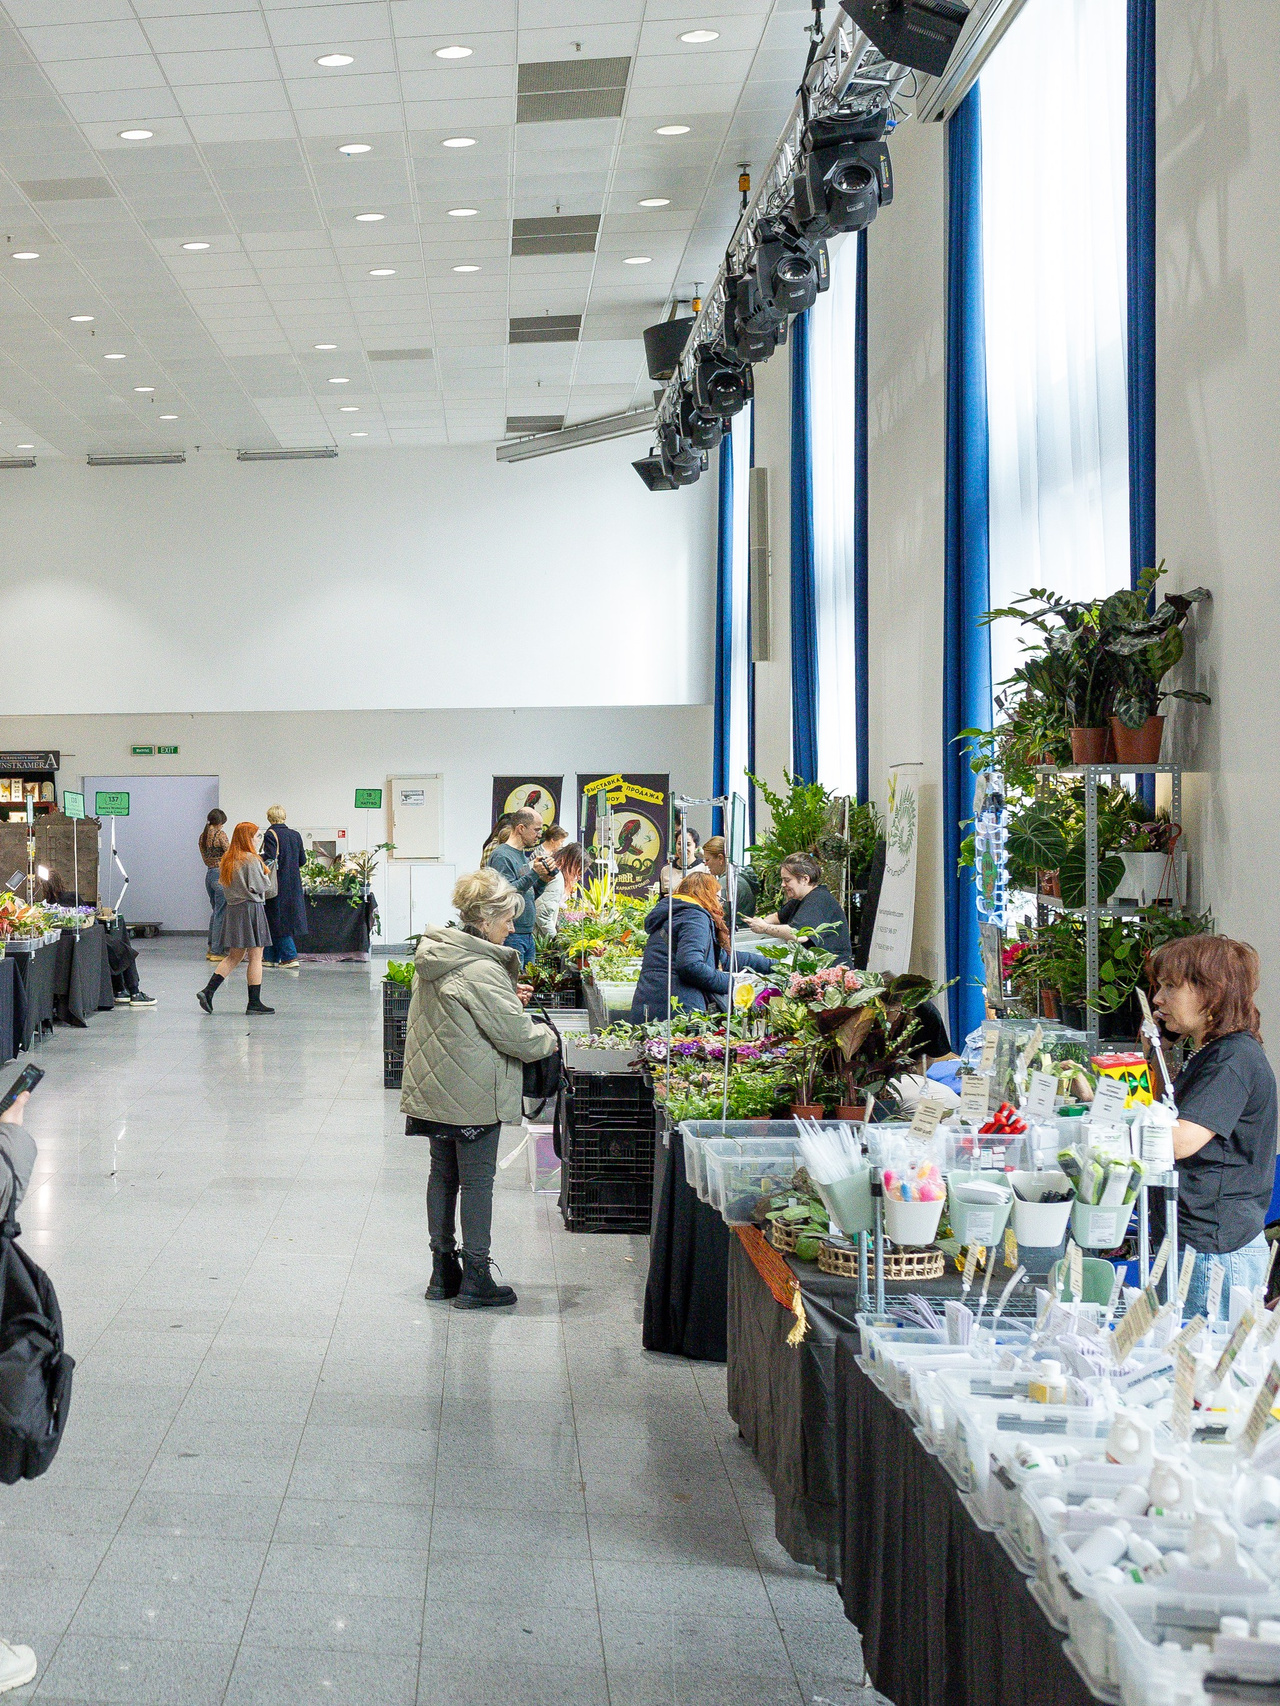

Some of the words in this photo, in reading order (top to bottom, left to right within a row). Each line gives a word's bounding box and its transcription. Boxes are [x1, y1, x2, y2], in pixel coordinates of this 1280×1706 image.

[160, 746, 175, 754] EXIT
[586, 778, 621, 793] ВЫСТАВКА
[626, 786, 660, 800] ПРОДАЖА
